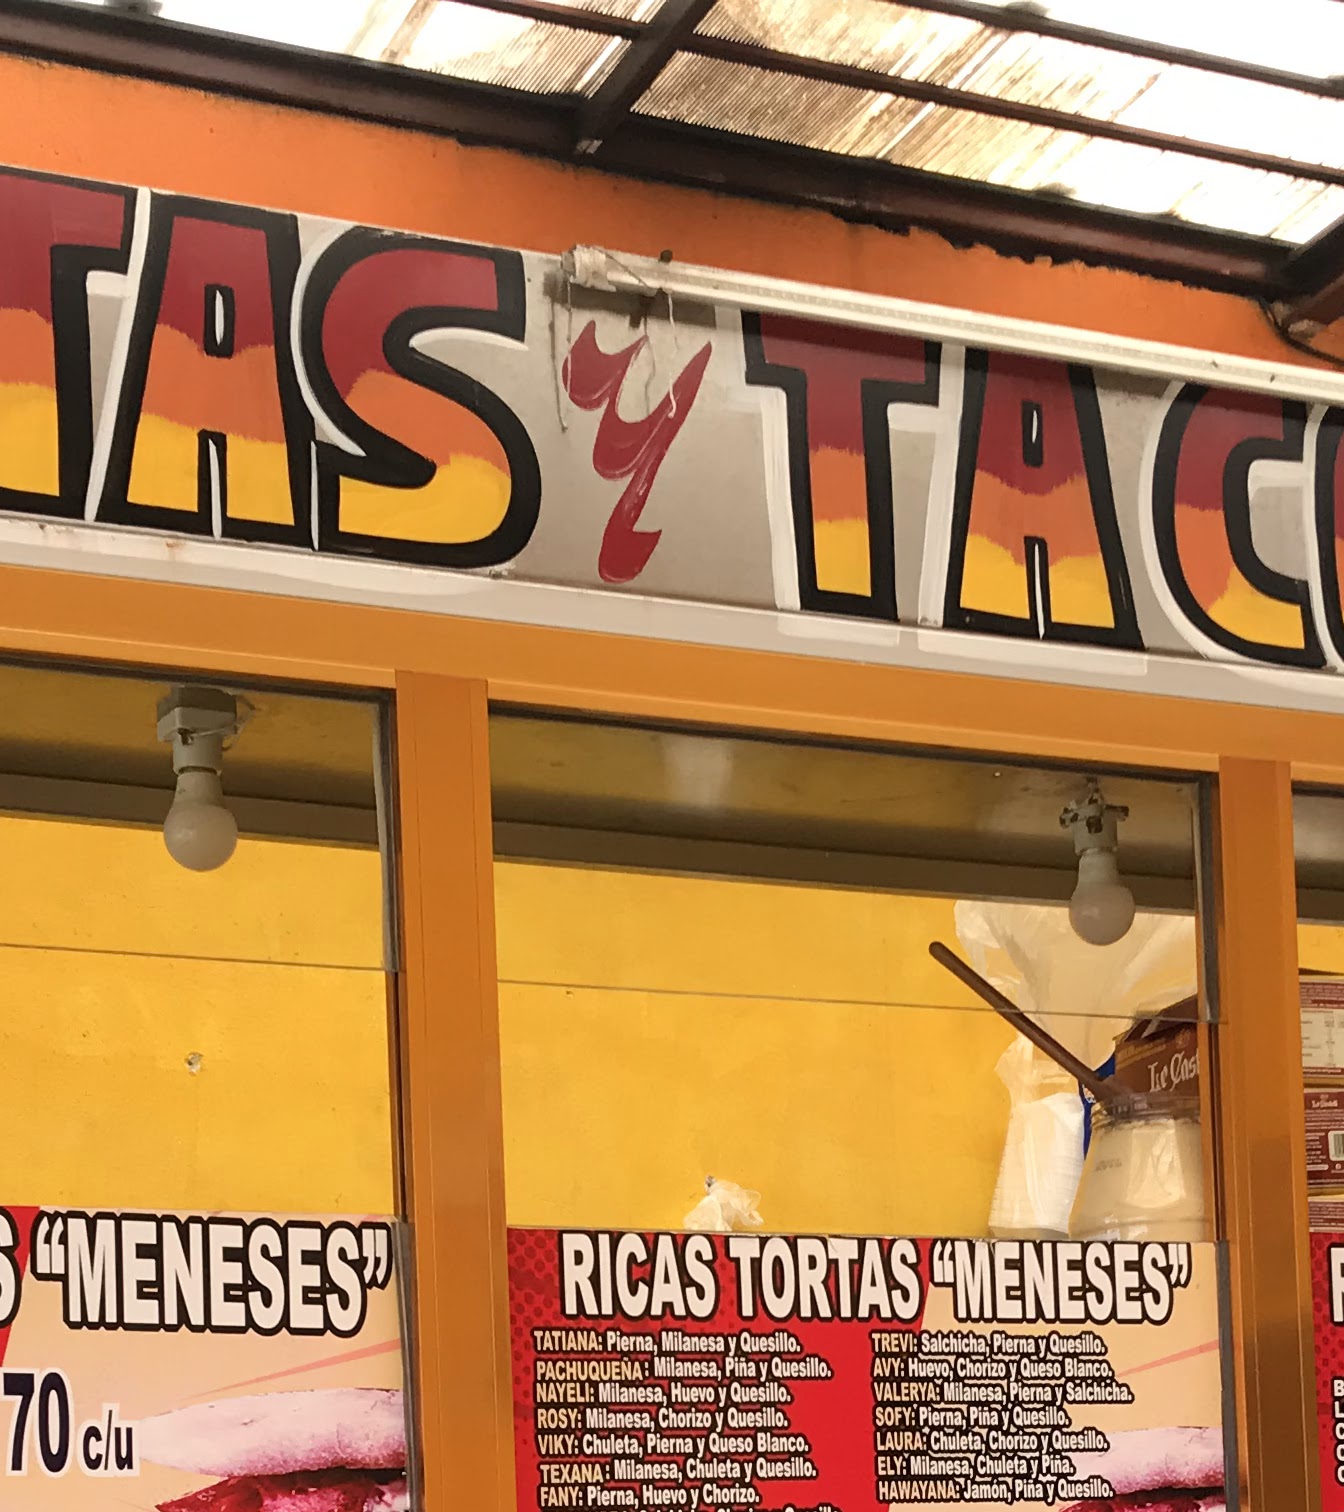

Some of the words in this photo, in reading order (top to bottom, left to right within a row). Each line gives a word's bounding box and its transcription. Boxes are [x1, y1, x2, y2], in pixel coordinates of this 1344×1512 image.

[562, 1232, 717, 1318] RICAS
[729, 1237, 920, 1320] TORTAS
[872, 1334, 918, 1353] TREVI:
[921, 1333, 991, 1355] Salchicha,
[993, 1334, 1035, 1353] Pierna
[1039, 1338, 1046, 1357] y
[1049, 1334, 1106, 1353] Quesillo.
[83, 1411, 134, 1470] c/u
[540, 1486, 583, 1507] FANY:
[587, 1486, 639, 1508] Pierna,
[642, 1485, 687, 1505] Huevo
[691, 1490, 699, 1510] y
[702, 1483, 760, 1504] Chorizo.
[878, 1480, 959, 1500] HAWAYANA:
[963, 1478, 1013, 1502] Jamón,
[1014, 1478, 1044, 1498] Piña
[1047, 1482, 1055, 1502] y
[1057, 1477, 1113, 1498] Quesillo.
